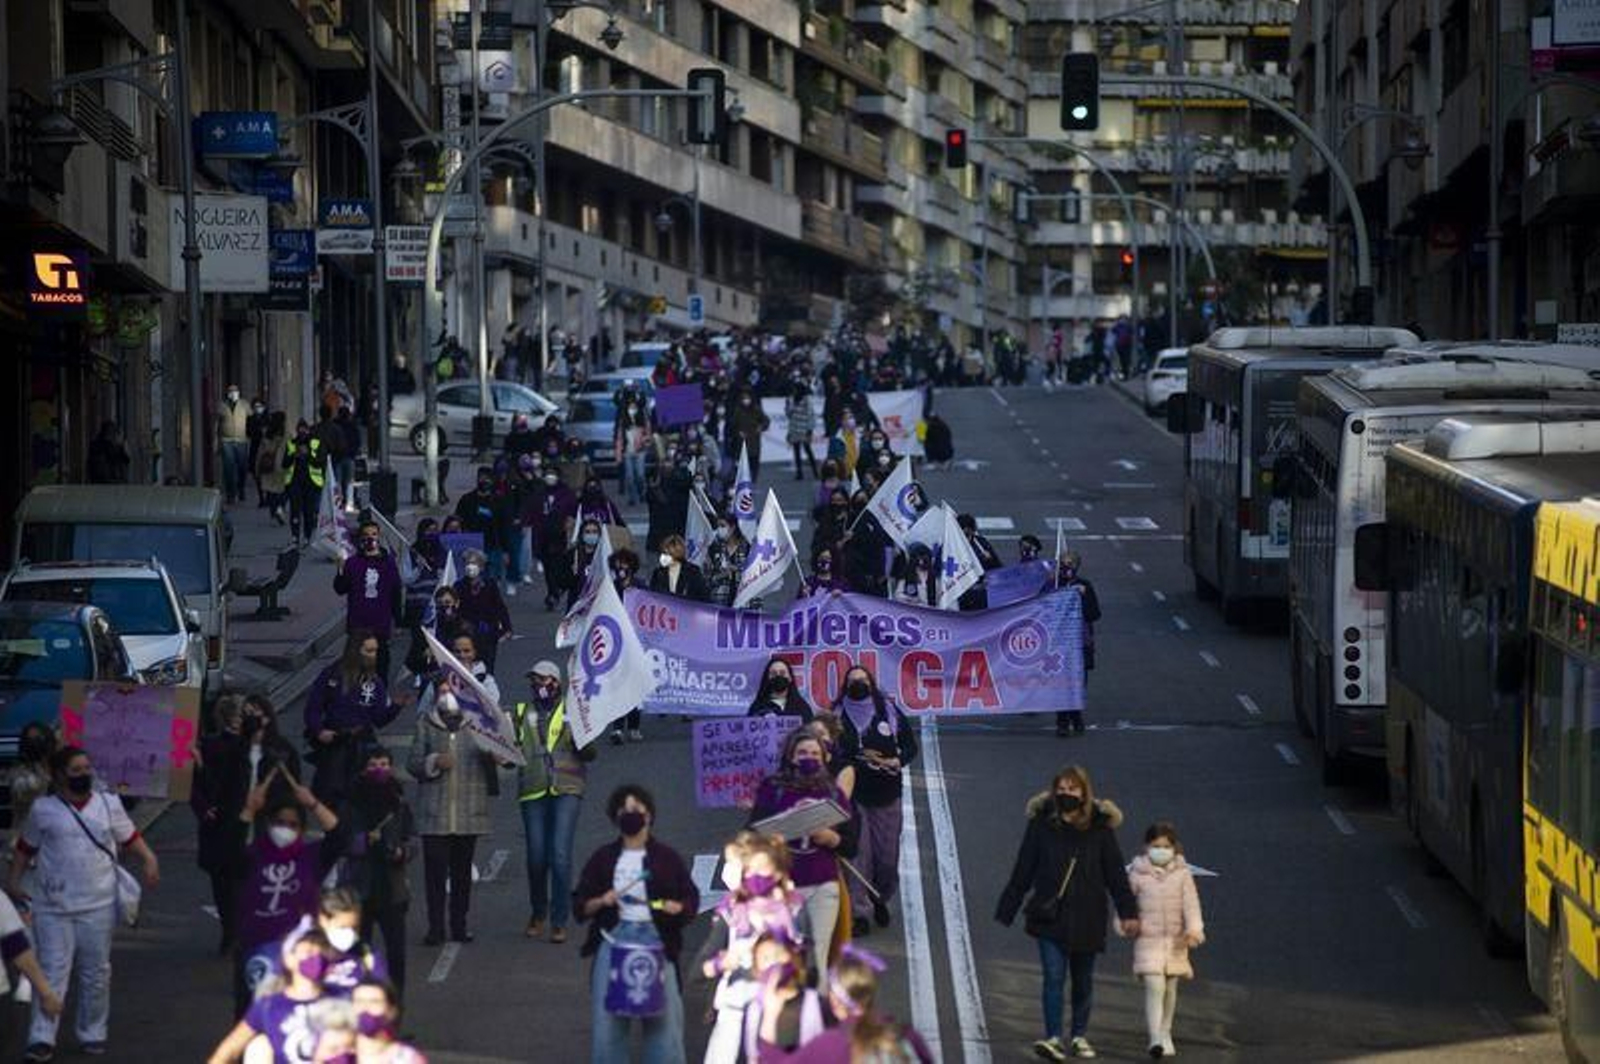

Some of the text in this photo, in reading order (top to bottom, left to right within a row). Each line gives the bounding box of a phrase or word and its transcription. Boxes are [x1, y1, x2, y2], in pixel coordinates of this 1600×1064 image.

[31, 293, 83, 303] TABACOS
[638, 604, 677, 632] CIG
[716, 604, 950, 650] Mulleres en
[668, 657, 689, 671] DE
[670, 671, 747, 690] MARZO
[703, 723, 720, 738] SE
